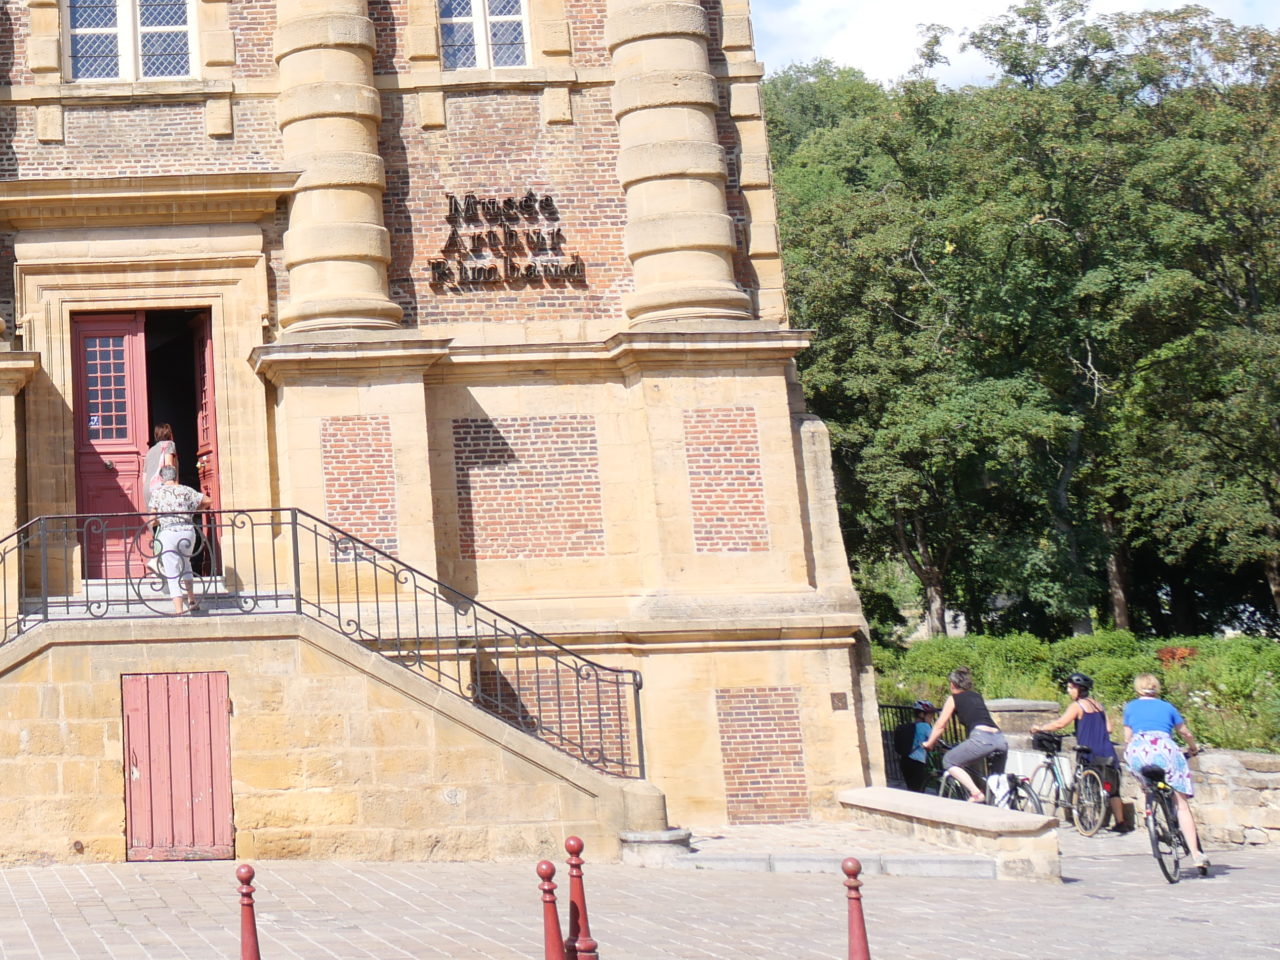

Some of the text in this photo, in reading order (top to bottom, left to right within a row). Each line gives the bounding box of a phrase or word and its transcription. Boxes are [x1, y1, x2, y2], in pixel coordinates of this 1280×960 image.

[445, 189, 557, 224] Musée
[441, 220, 565, 255] Arthur
[428, 252, 586, 287] Rimbaud
